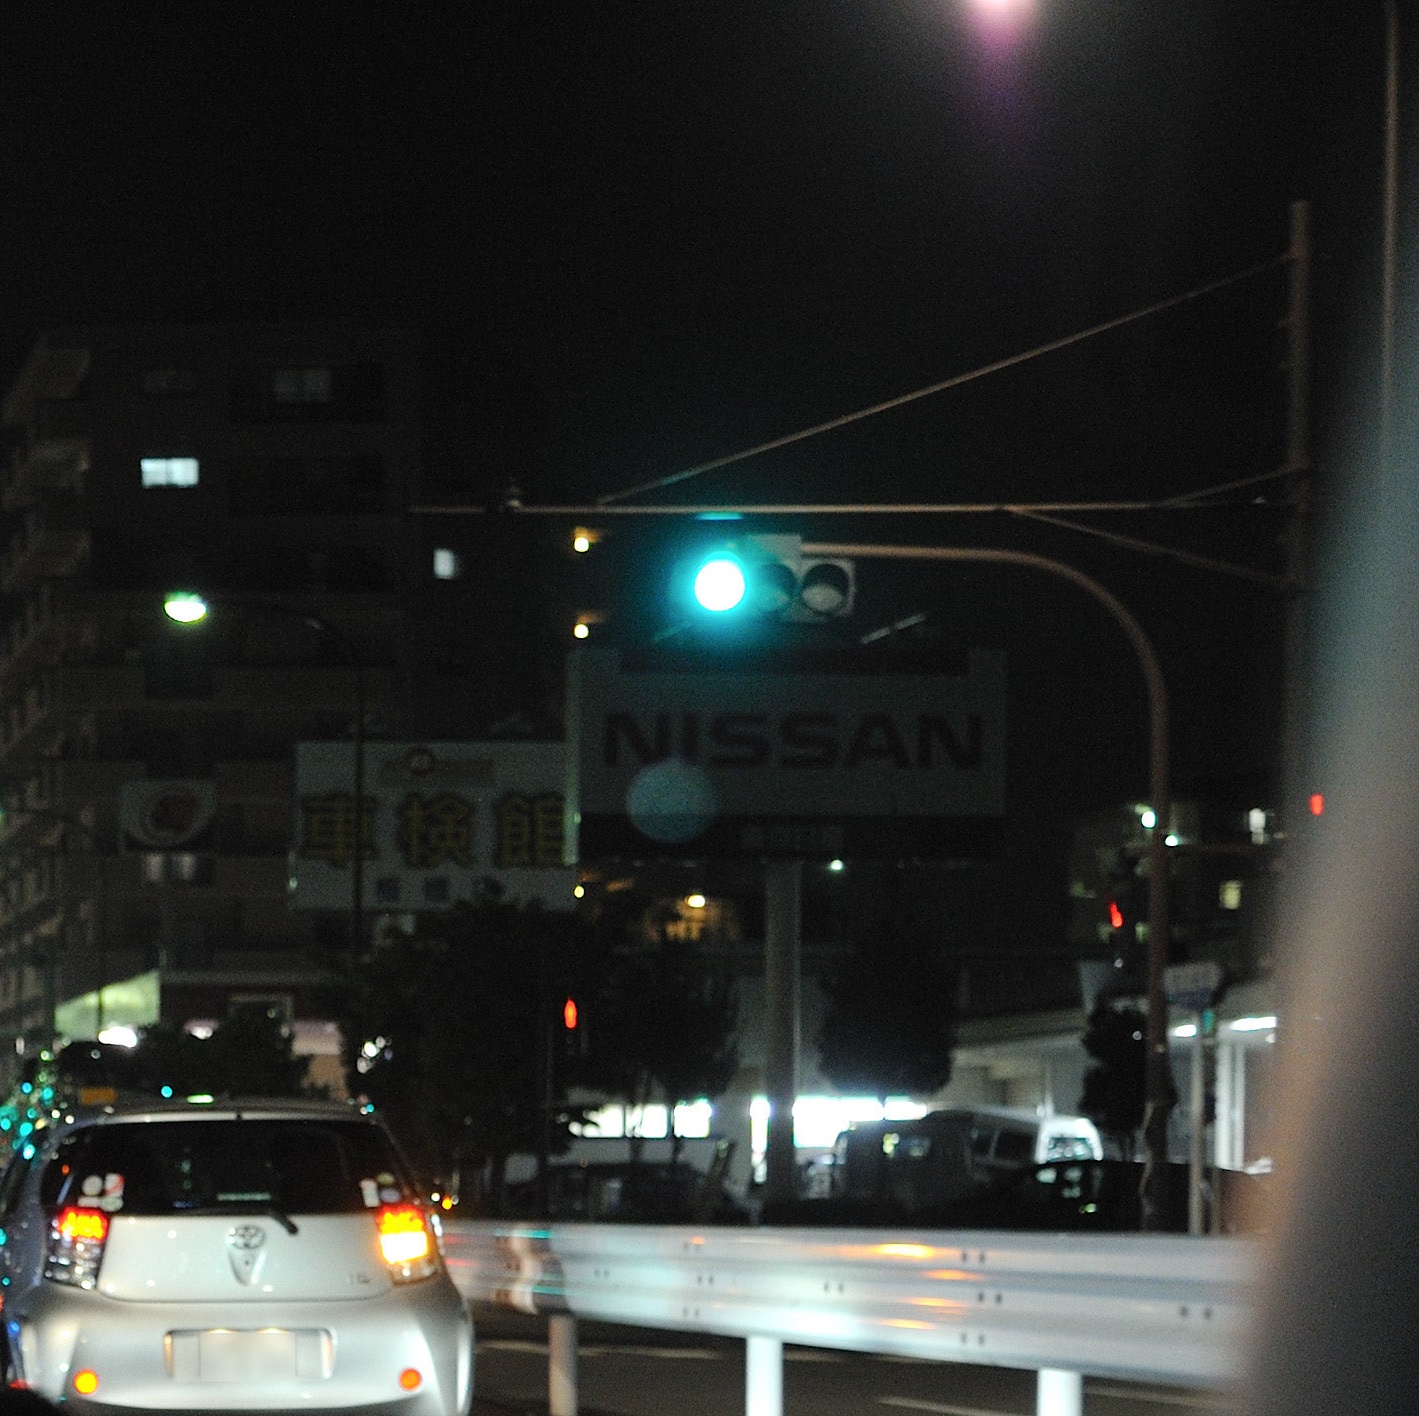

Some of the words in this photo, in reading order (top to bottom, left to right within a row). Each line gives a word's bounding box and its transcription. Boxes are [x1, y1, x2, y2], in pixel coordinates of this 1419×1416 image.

[606, 711, 983, 771] NISSAN
[302, 792, 564, 868] 車検館
